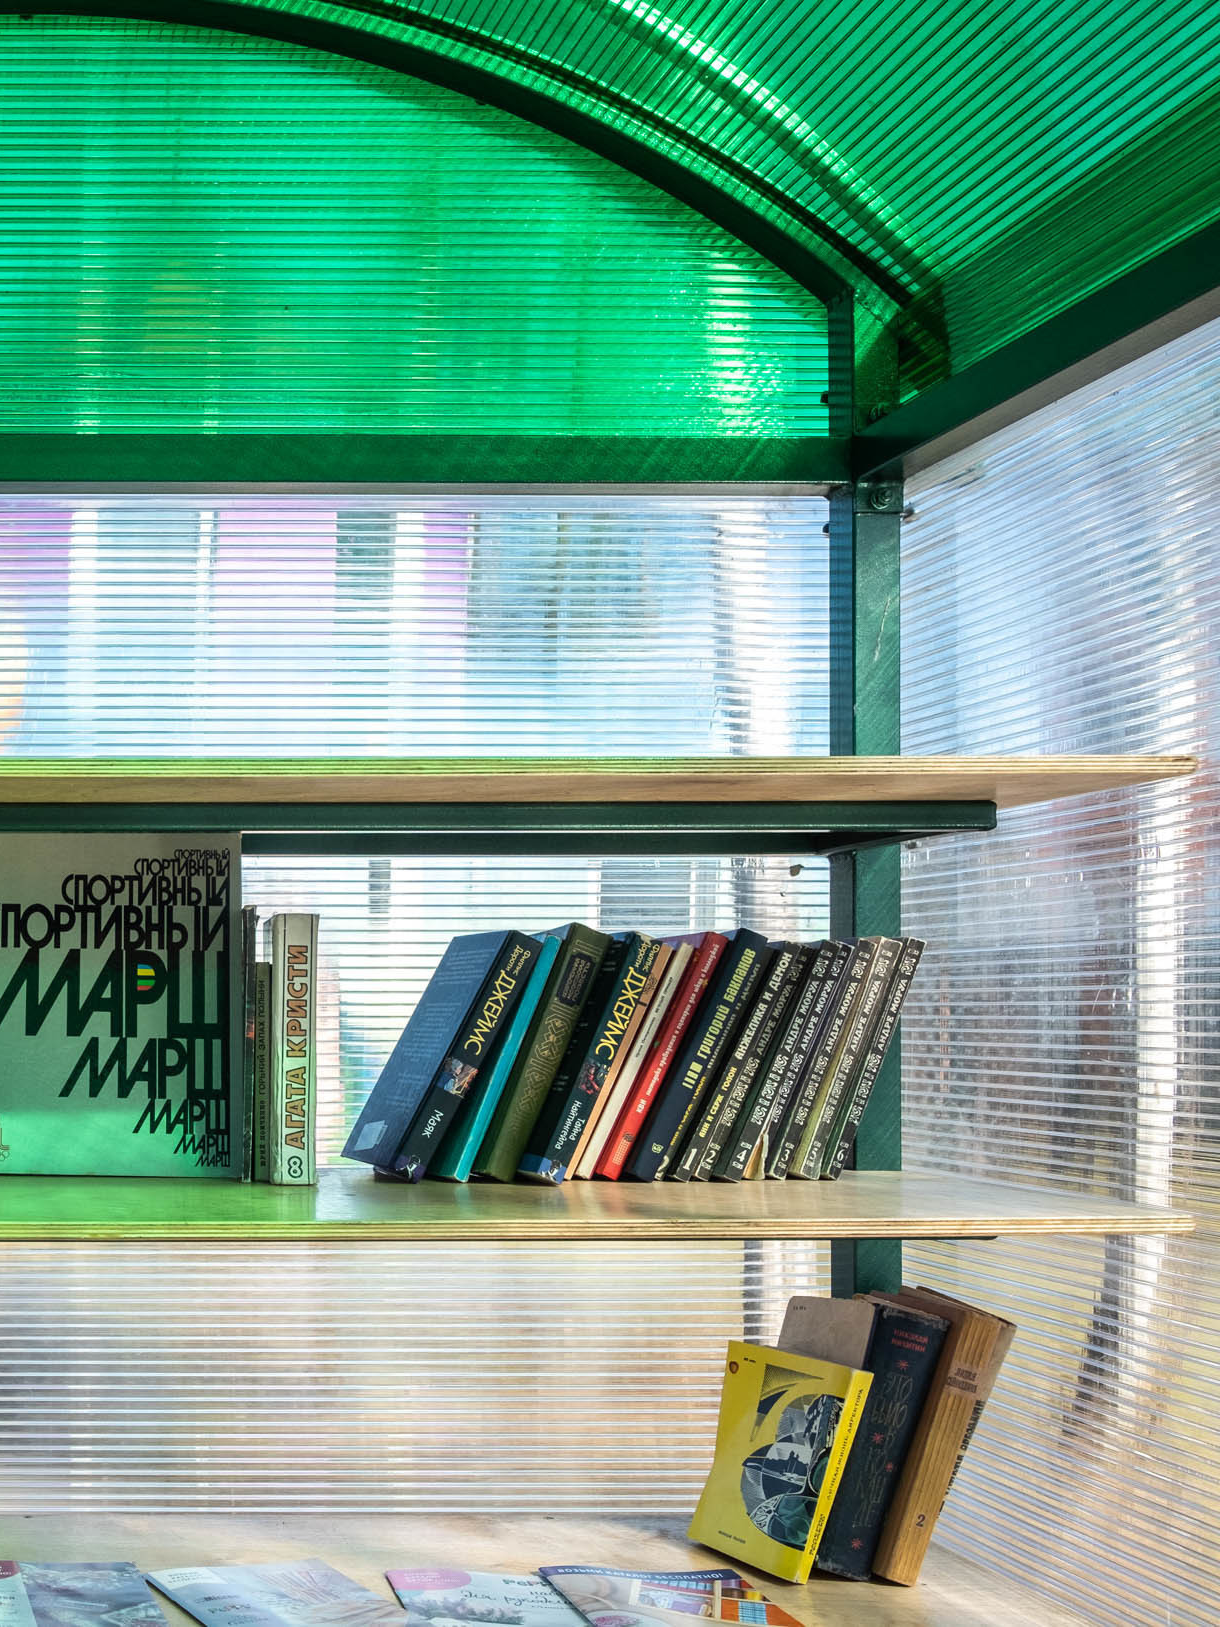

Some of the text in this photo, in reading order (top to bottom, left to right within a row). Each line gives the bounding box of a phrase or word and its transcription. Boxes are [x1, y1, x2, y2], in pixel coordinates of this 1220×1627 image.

[134, 857, 230, 877] СПОРТИВНЫЙ
[61, 873, 230, 907] СПОРТИВНЫЙ
[459, 969, 518, 1056] ДЖЕЙМС
[595, 966, 647, 1060] ДЖЕЙМС
[733, 1001, 768, 1061] АНЖЕЛИКА
[762, 990, 774, 1002] И
[768, 951, 794, 991] ДЕМОН
[782, 977, 820, 1053] АНДРЕ МОРУА
[798, 977, 835, 1051] АНДРЕ МОРУА
[822, 979, 859, 1054] АНДРЕ МОРУА
[847, 978, 882, 1053] АНДРЕ МОРУА
[875, 977, 909, 1051] АНДРЕ МОРУА
[58, 1036, 230, 1099] МАРШ
[285, 945, 308, 1150] АГАТА КРИСТИ
[720, 1064, 738, 1092] ГОЛОН
[132, 1098, 230, 1135] МАРШ
[420, 1108, 443, 1139] Маяк
[555, 1100, 582, 1150] Найтингейла
[635, 1098, 647, 1113] КВН
[173, 1134, 230, 1155] МАРШ
[568, 1117, 586, 1142] Тайна
[195, 1153, 230, 1168] МАРШ
[287, 1155, 304, 1179] 8
[915, 1514, 927, 1528] 2
